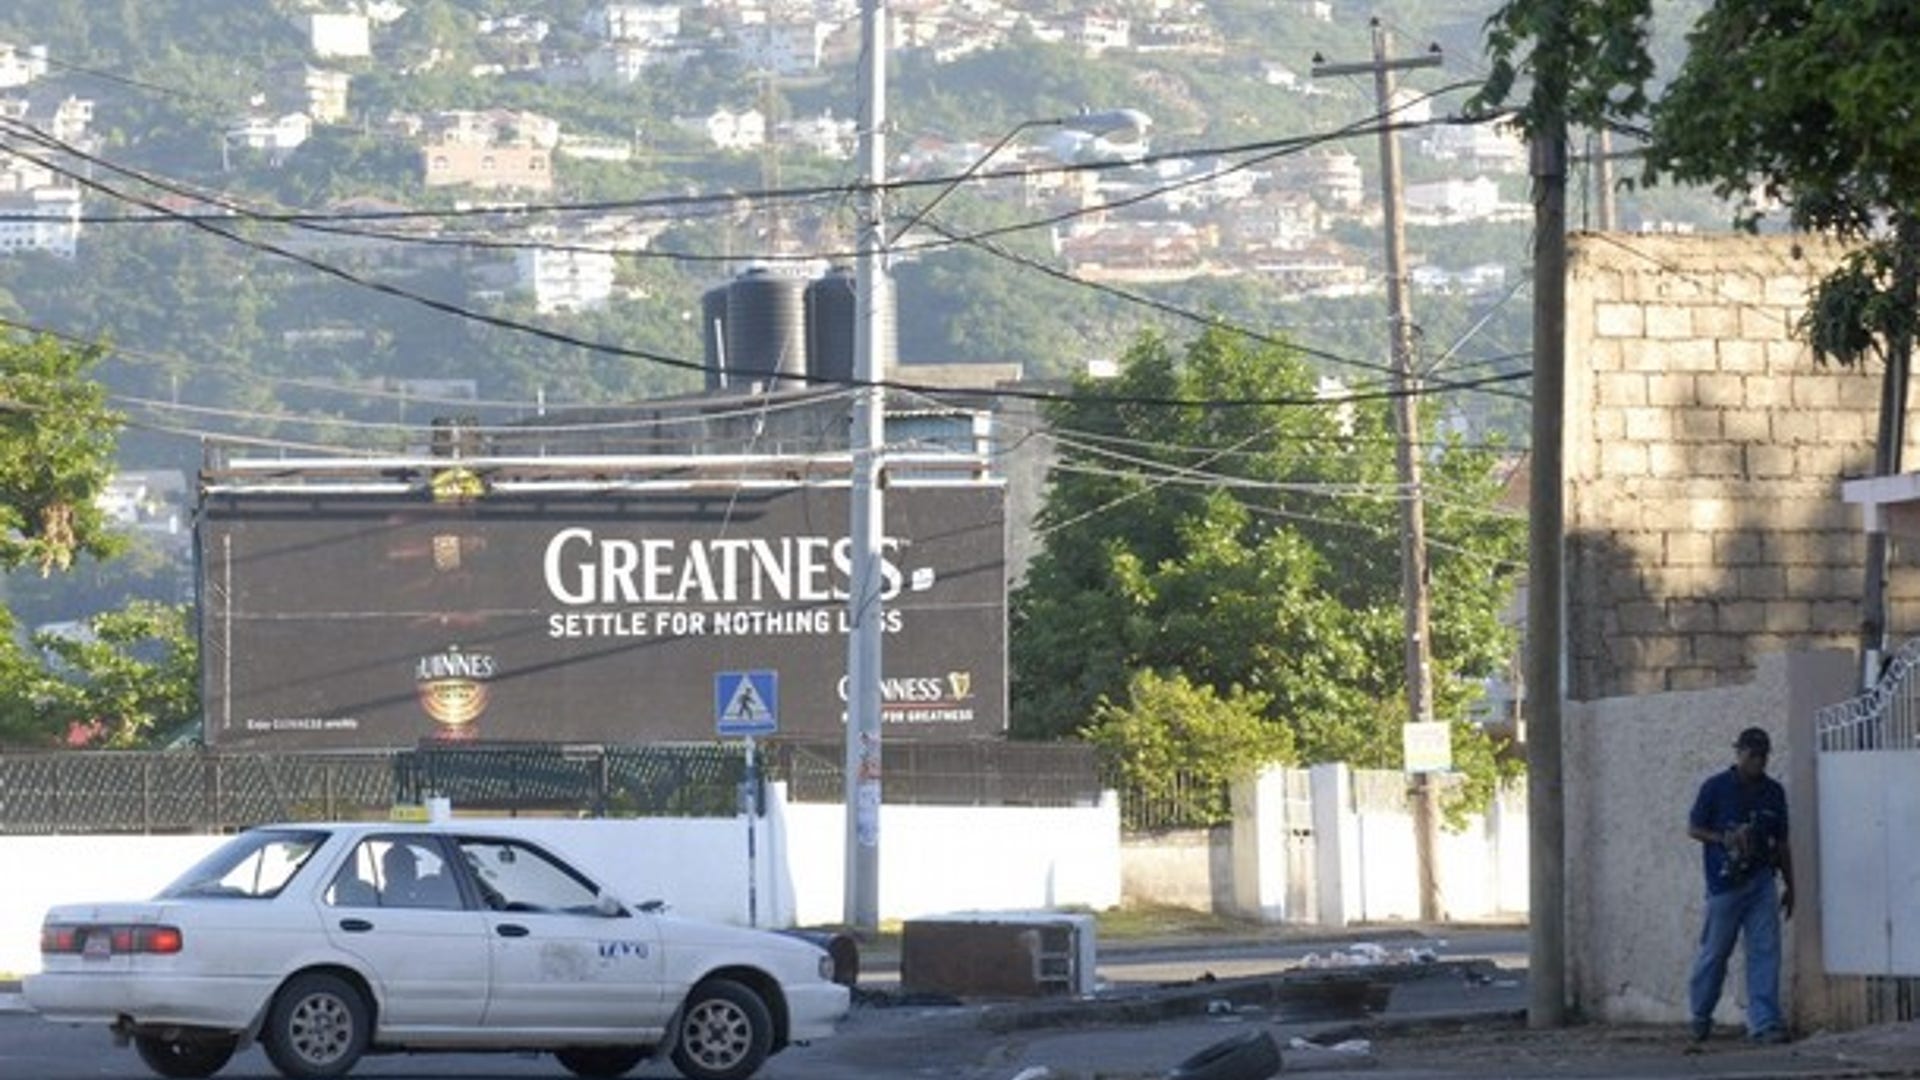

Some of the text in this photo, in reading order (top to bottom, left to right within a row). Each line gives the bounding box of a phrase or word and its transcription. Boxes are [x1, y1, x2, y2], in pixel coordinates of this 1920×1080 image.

[549, 609, 904, 638] SETTLE FOR NOTHING LS
[837, 675, 942, 702] GNNESS
